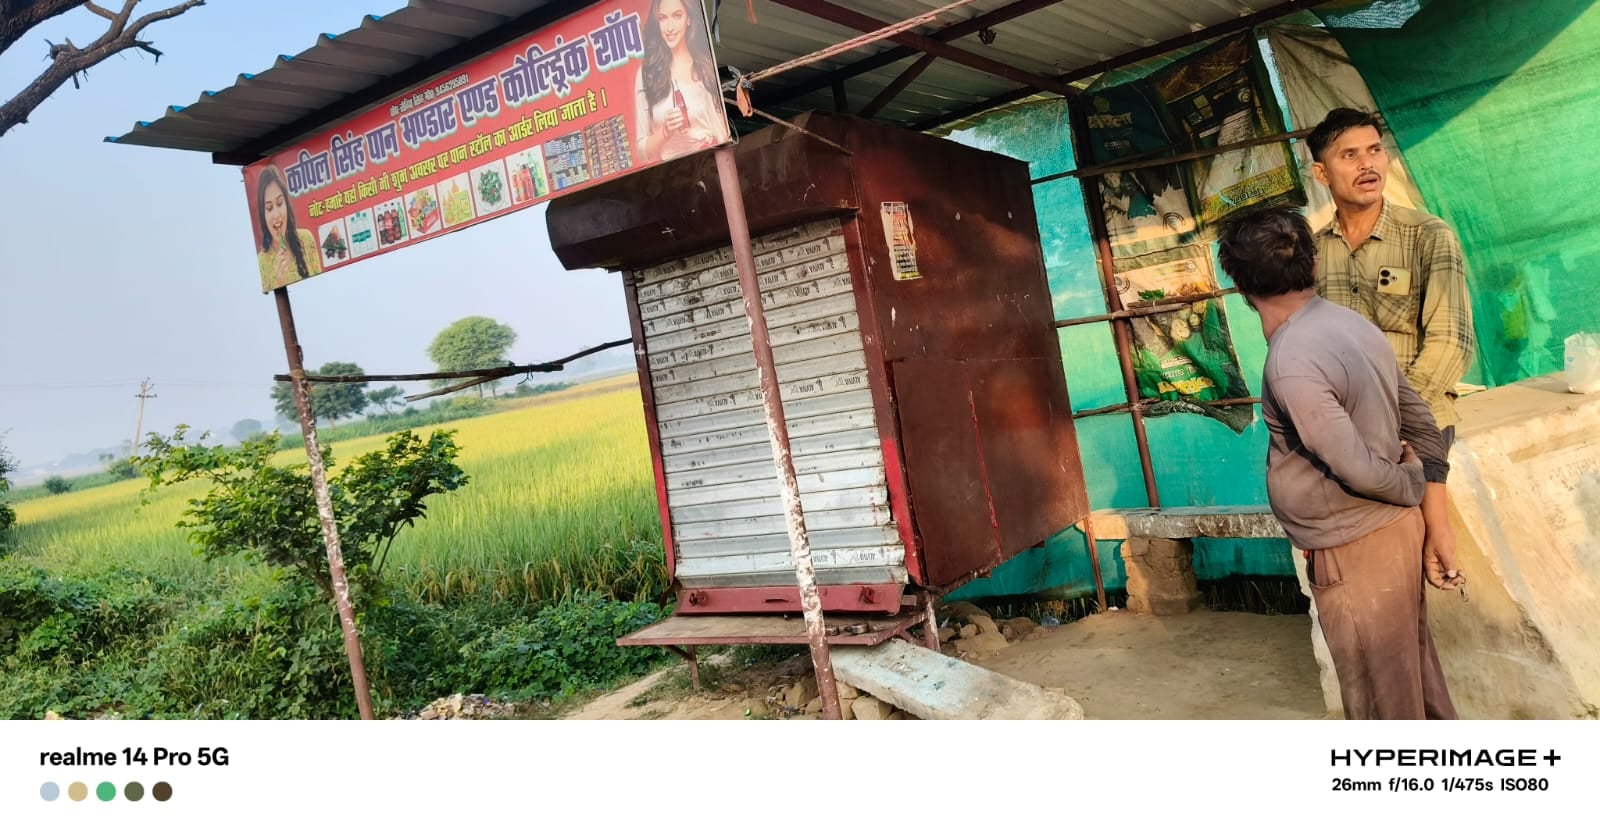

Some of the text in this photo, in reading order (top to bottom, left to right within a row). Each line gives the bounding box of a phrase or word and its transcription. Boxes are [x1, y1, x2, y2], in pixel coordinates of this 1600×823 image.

[284, 149, 331, 194] कपिल
[331, 131, 366, 177] सिंह
[366, 123, 398, 161] पान
[400, 97, 455, 145] भण्डार
[457, 78, 499, 121] एण्ड
[591, 12, 642, 66] शॉप
[358, 176, 378, 200] किसी
[379, 171, 391, 191] भी
[391, 168, 408, 192] शुभ
[409, 157, 437, 180] अवसर
[436, 152, 450, 169] पर
[449, 145, 468, 164] पान
[469, 133, 493, 157] स्टॉल
[493, 129, 507, 147] का
[534, 109, 559, 133] लिया
[560, 97, 587, 120] जाता
[586, 89, 597, 112] है
